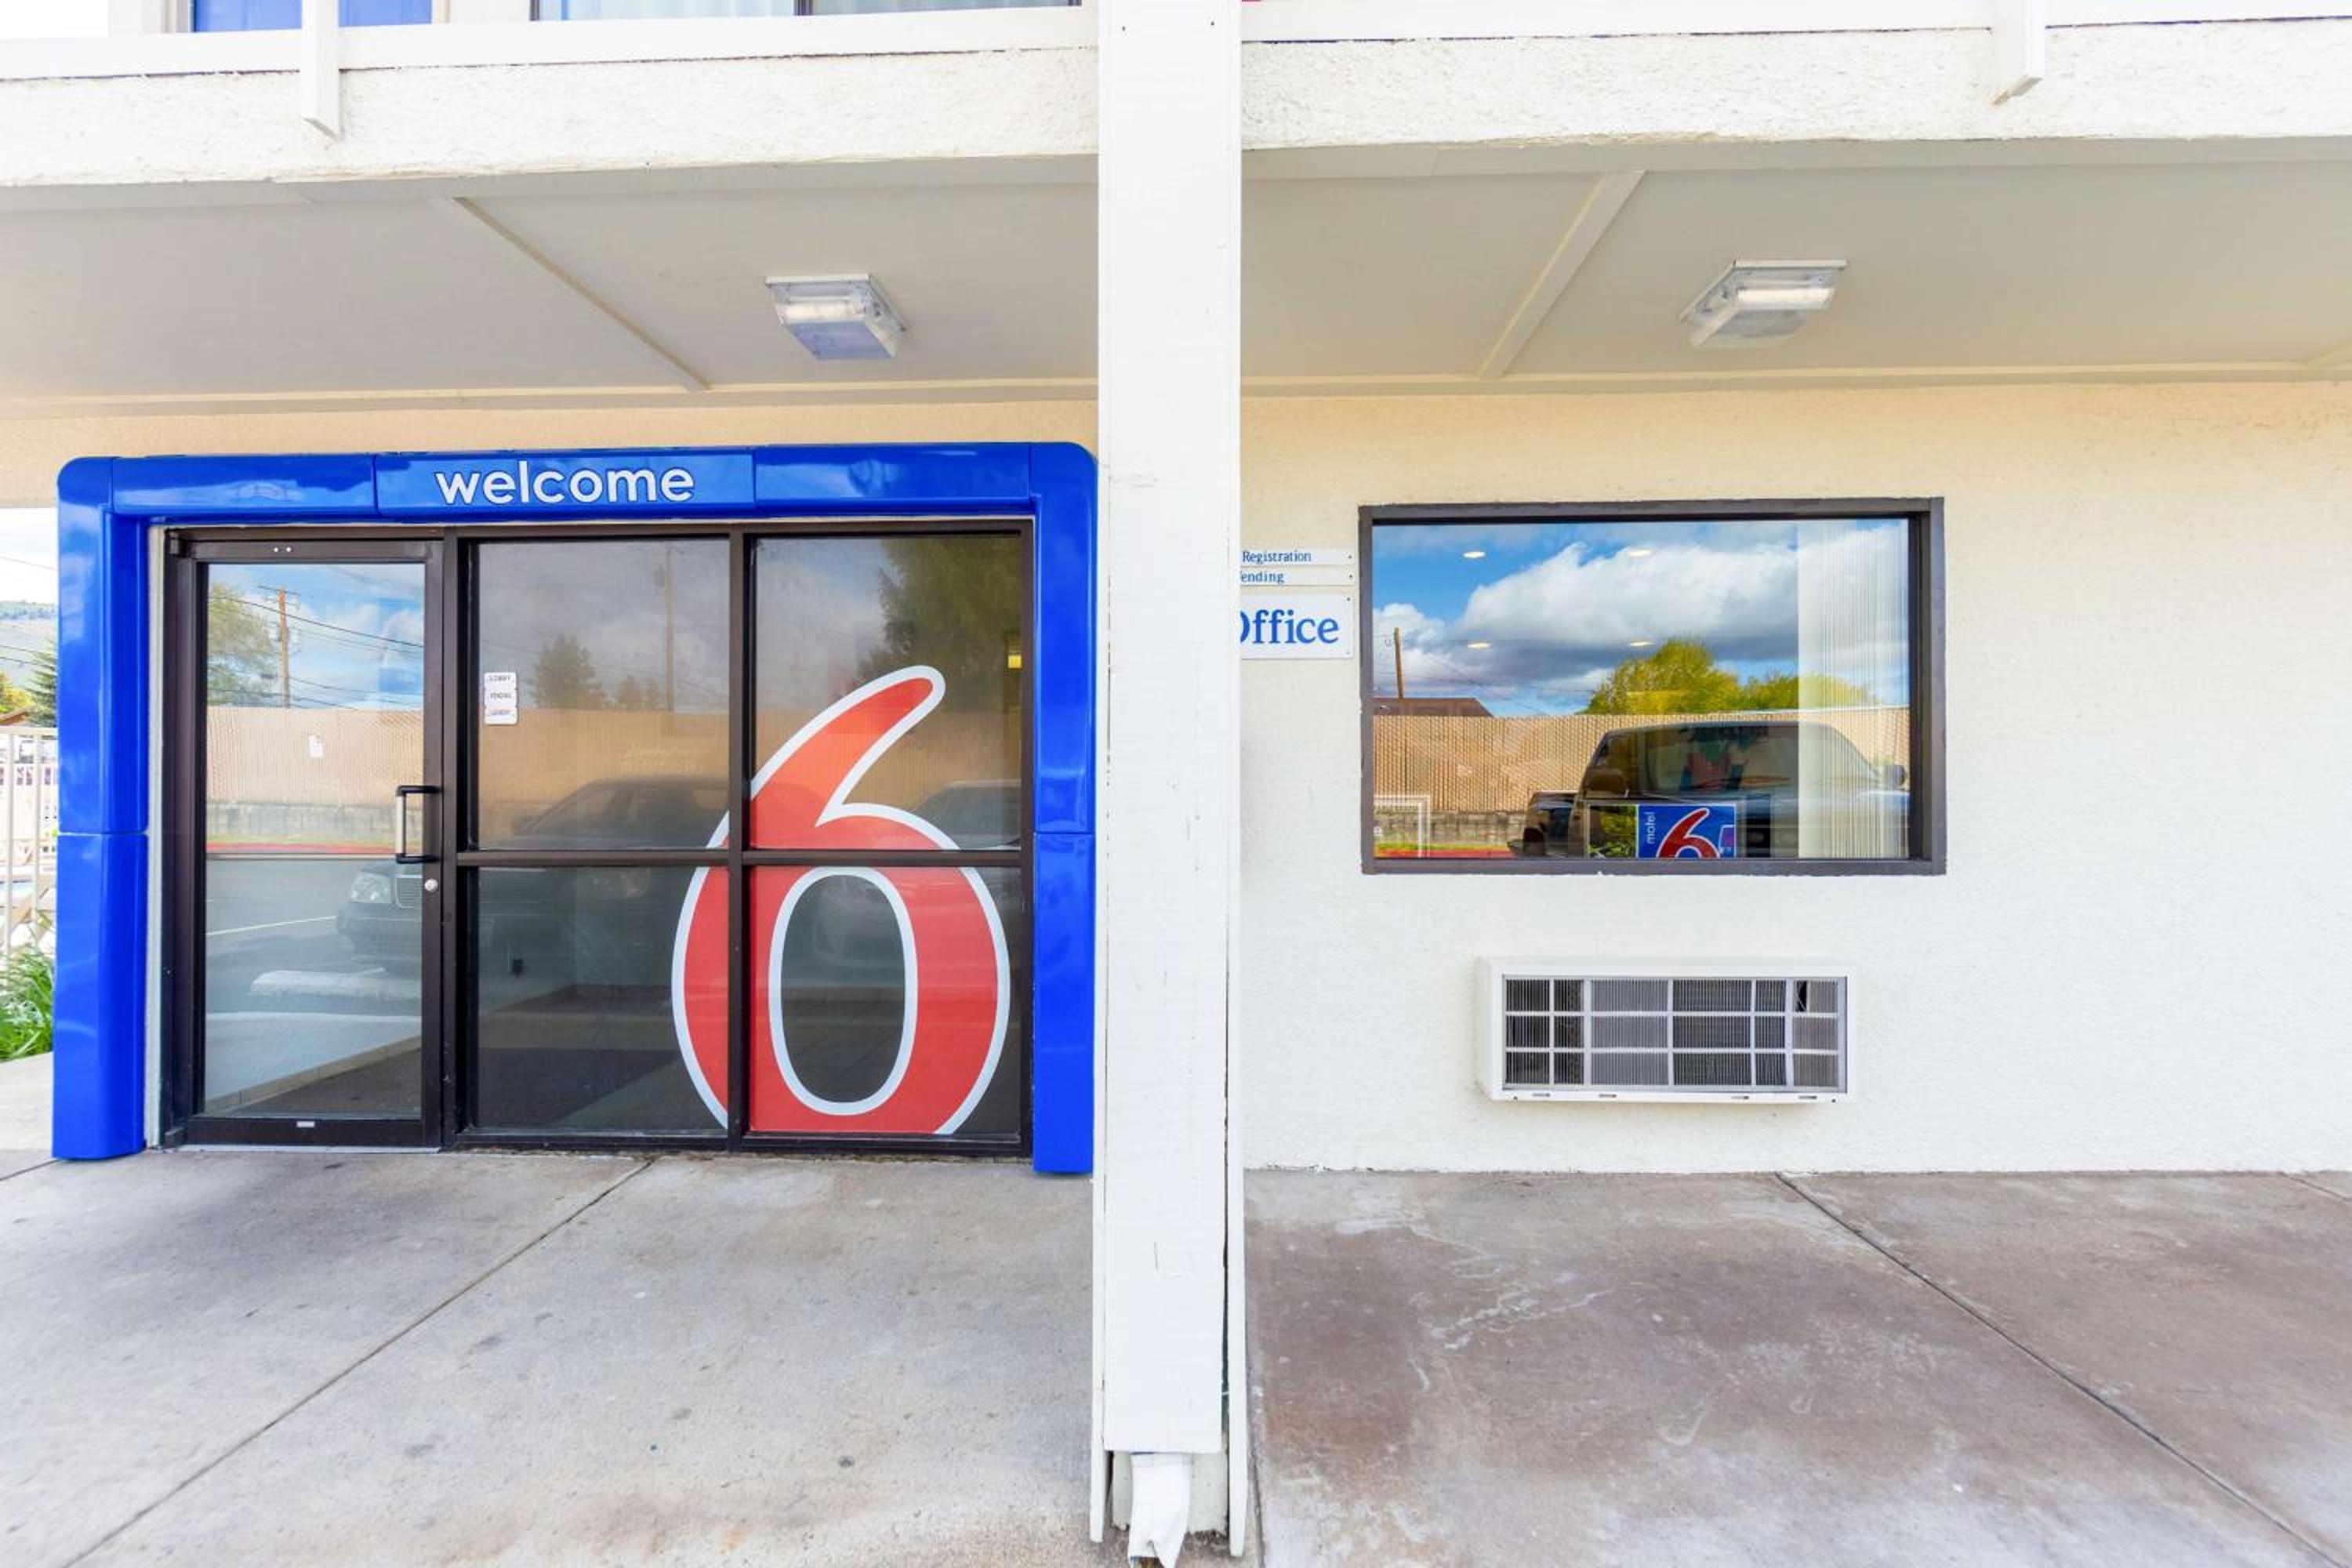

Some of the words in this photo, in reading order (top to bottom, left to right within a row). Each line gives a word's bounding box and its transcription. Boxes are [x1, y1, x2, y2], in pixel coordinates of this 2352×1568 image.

[435, 460, 695, 504] welcome
[1242, 550, 1312, 564] Registration
[1240, 571, 1285, 583] ending
[1645, 811, 1656, 845] motel
[671, 664, 1011, 1136] 6
